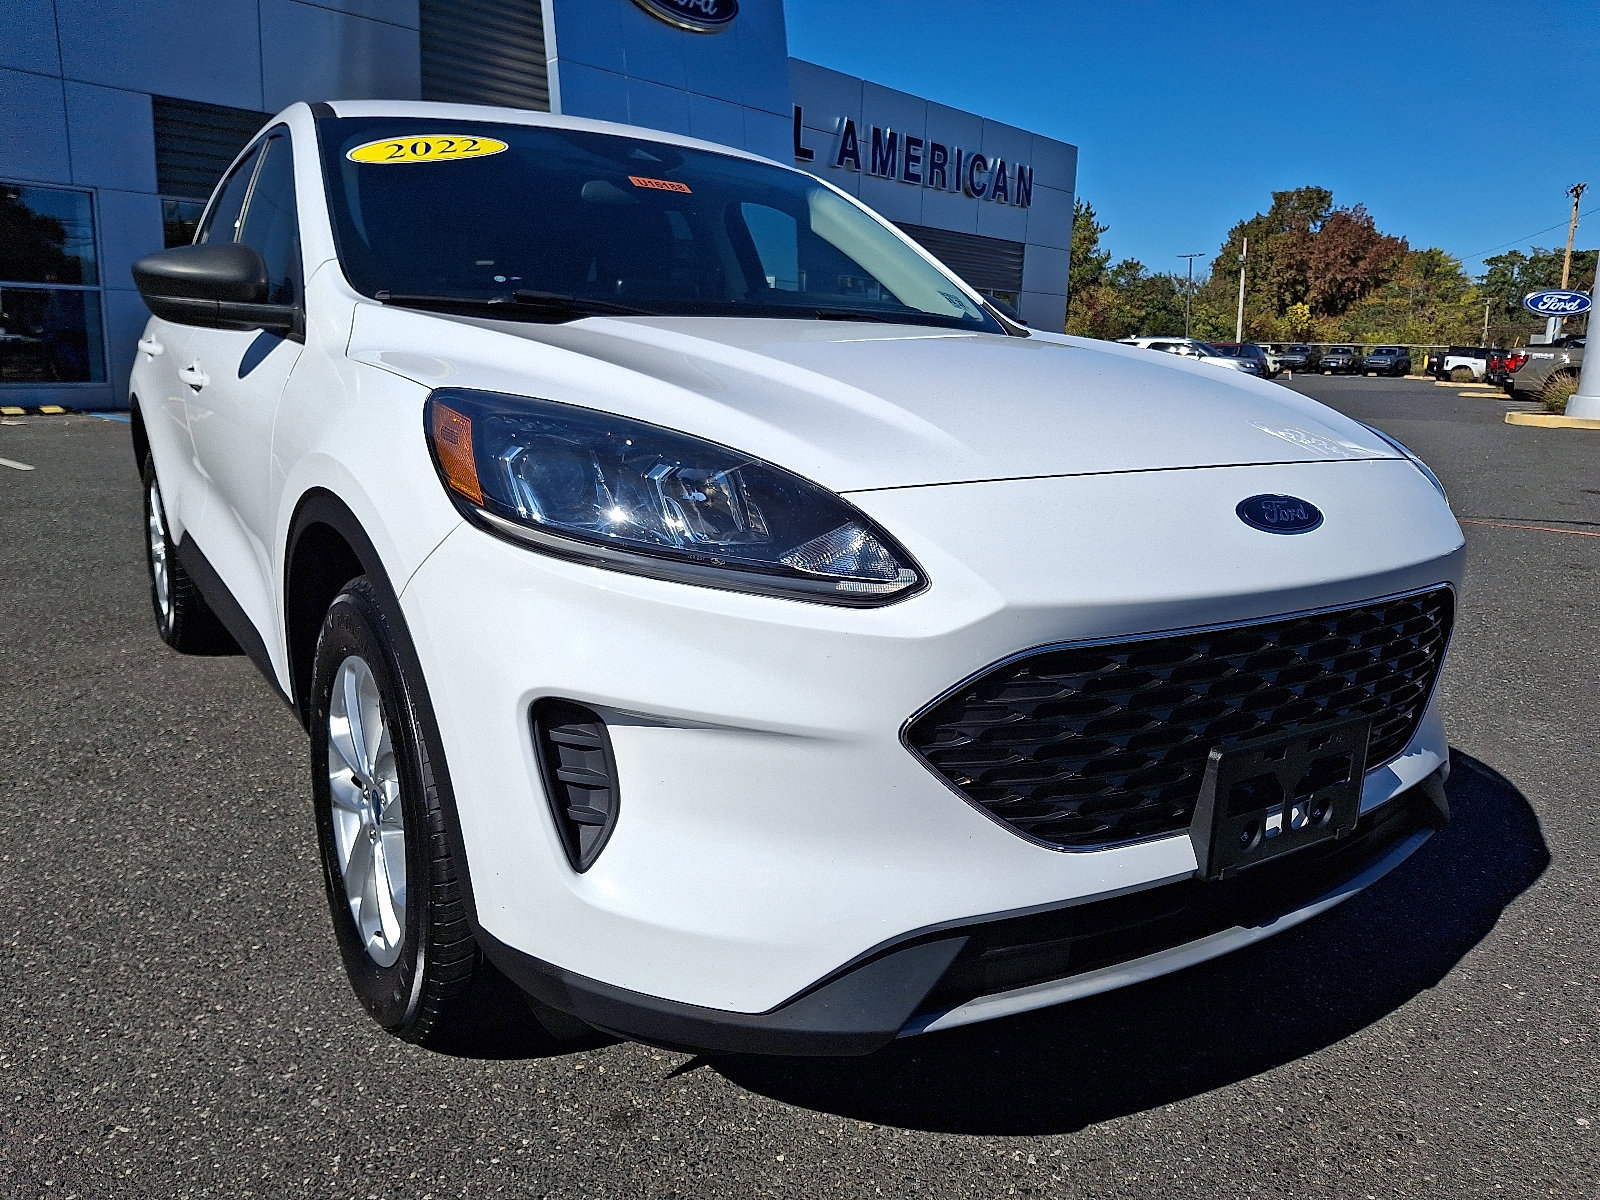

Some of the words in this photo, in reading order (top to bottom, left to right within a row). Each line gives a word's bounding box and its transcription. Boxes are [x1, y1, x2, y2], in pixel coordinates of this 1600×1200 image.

[384, 139, 481, 160] 2022
[832, 115, 1034, 208] AMERICAN
[1537, 294, 1581, 311] Ford
[1260, 500, 1309, 523] Ford
